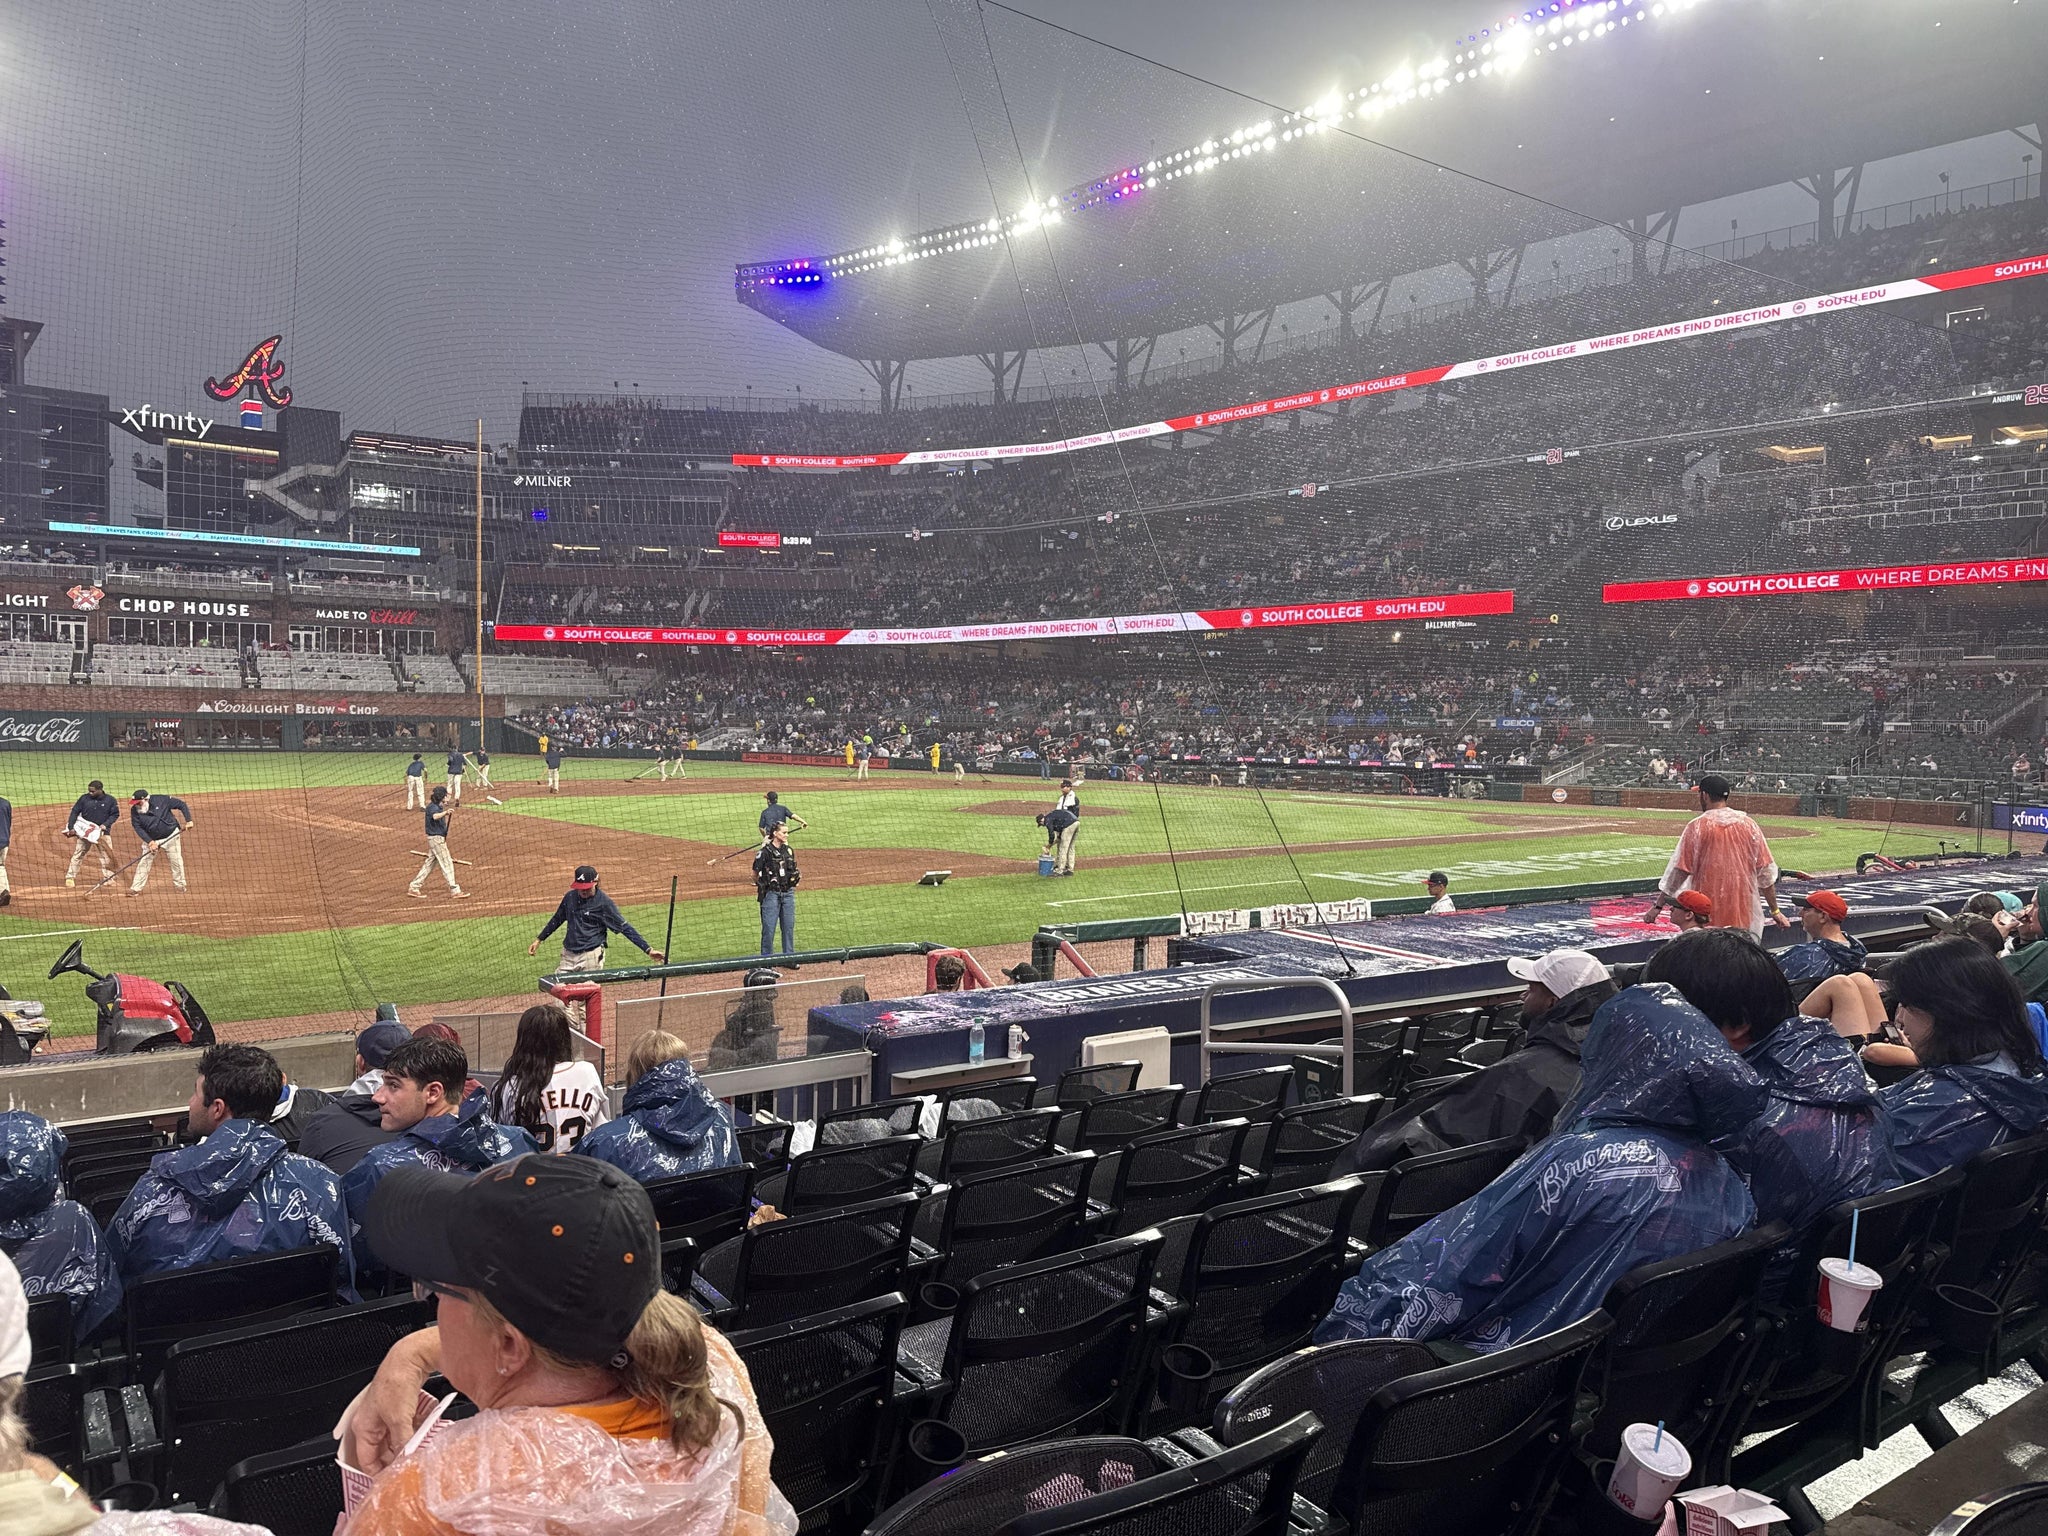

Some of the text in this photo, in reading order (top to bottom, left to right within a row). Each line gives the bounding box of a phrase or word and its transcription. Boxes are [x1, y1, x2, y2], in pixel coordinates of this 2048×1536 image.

[1817, 289, 1887, 309] SOUTH.EDU
[1495, 307, 1781, 367] SOUTH COLLEGE WHERE DREAMS FIND DIRECTION
[204, 335, 293, 410] A
[1336, 376, 1407, 398] SOUTH COLLEGE
[1992, 384, 2048, 406] ANDRUW 25
[1207, 395, 1314, 423] SOUTH COLLEGE SOUTH.EDU
[121, 404, 214, 439] xfinity
[933, 436, 1102, 460] SOUTH COLLEGE WHERE DREAMS FIND DIRECTION
[1546, 447, 1562, 465] 21
[775, 457, 801, 465] SOUTH
[525, 476, 572, 487] MILNER
[1302, 482, 1316, 498] 10
[1625, 513, 1678, 528] LEXUS
[800, 537, 812, 545] PM
[1707, 563, 2048, 593] SOUTH COLLEGE WHERE DREAMS FIN
[119, 598, 250, 617] CHOP HOUSE
[315, 608, 418, 625] MADE TO Chill
[1261, 601, 1446, 623] SOUTH COLLEGE SOUTH.EDU
[563, 629, 717, 641] SOUTH COLLEGE SOUTH.EDU
[746, 632, 826, 642] SOUTH COLLEGE
[886, 621, 1098, 641] SOUTH COLLEGE WHERE DREAMS FIND DIRECTION
[214, 700, 290, 714] Coors LIGHT
[295, 703, 335, 715] BELOW
[350, 704, 380, 715] CHOP
[0, 717, 85, 743] Coca-Cola
[155, 721, 180, 729] LIGHT
[1502, 719, 1535, 727] GEICO
[2012, 811, 2048, 829] xfinity
[1040, 969, 1251, 1002] BRAVES.COM
[1535, 1138, 1657, 1215] Braves
